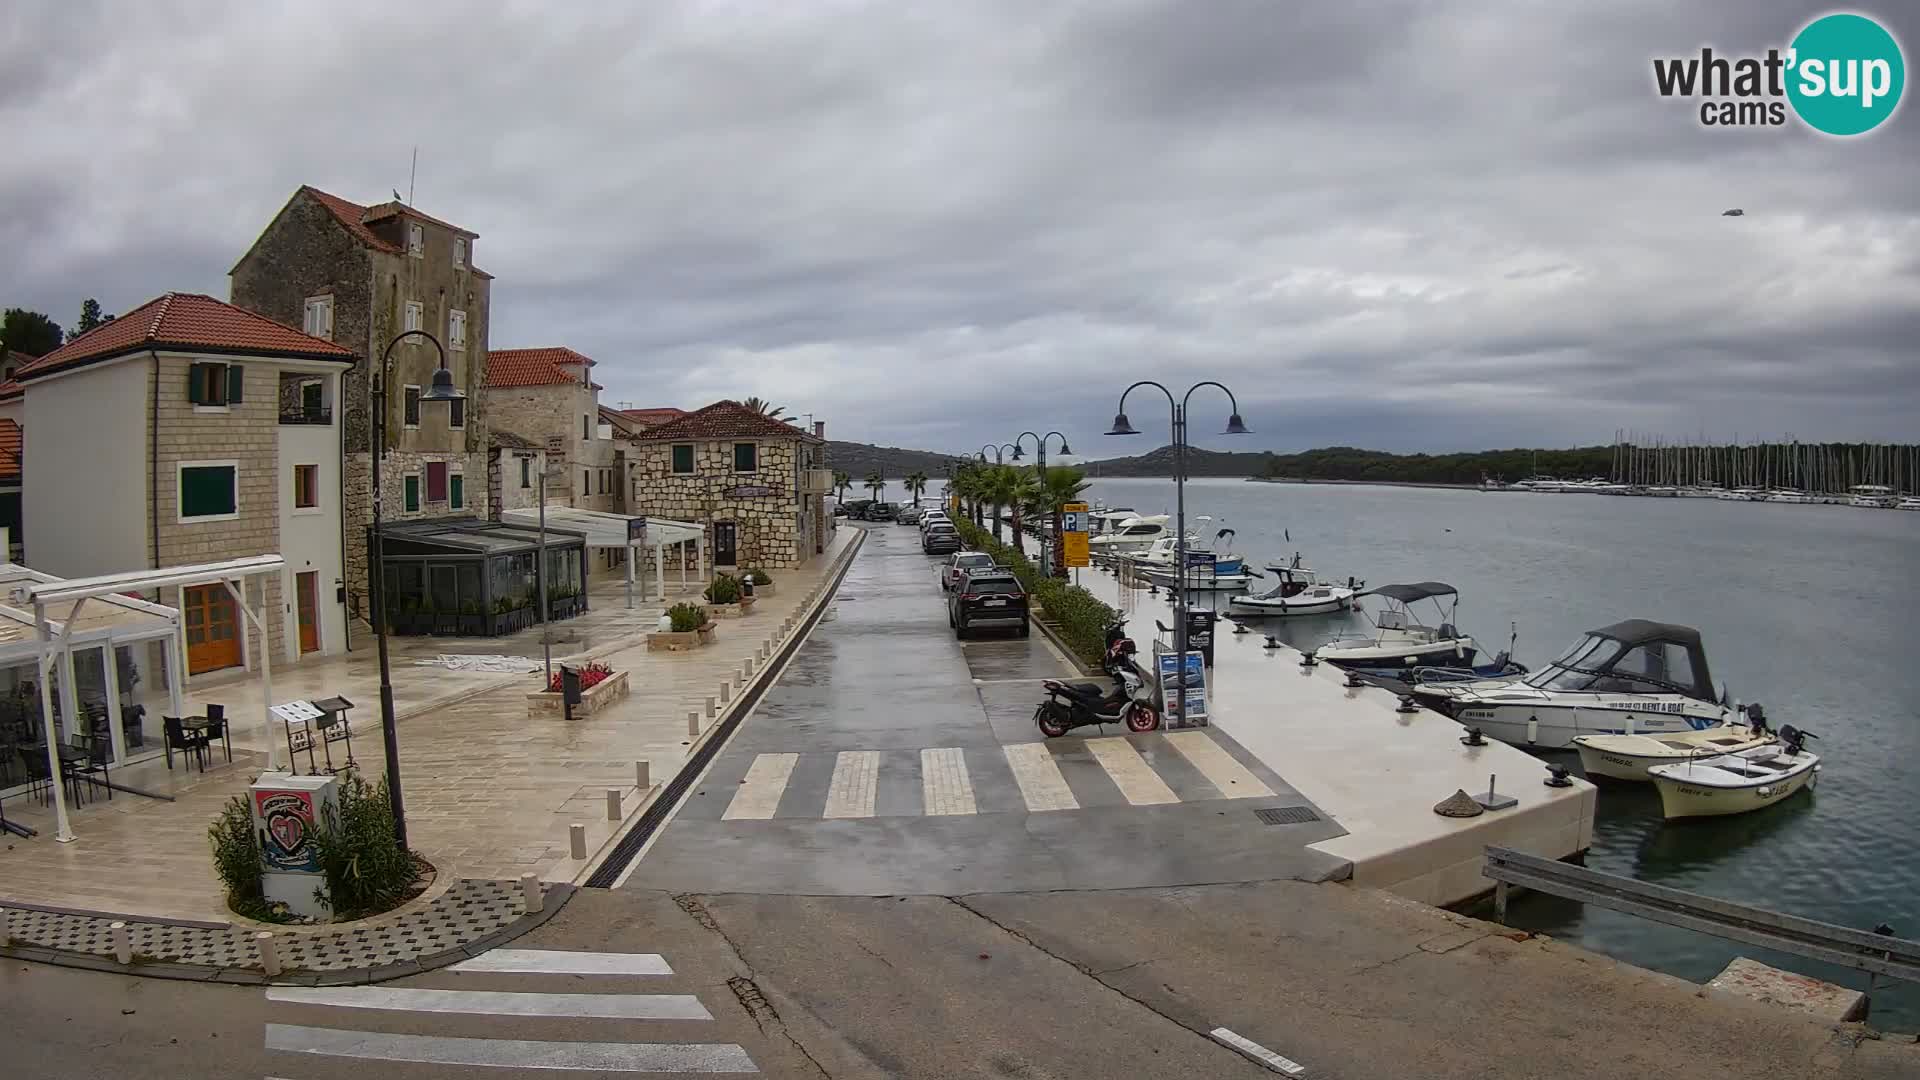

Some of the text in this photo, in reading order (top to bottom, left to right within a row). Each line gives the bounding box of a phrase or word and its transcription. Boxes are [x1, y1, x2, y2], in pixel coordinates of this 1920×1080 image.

[1065, 514, 1076, 530] P
[1642, 702, 1661, 712] RENT
[1661, 703, 1666, 712] A
[1667, 703, 1685, 713] BOAT
